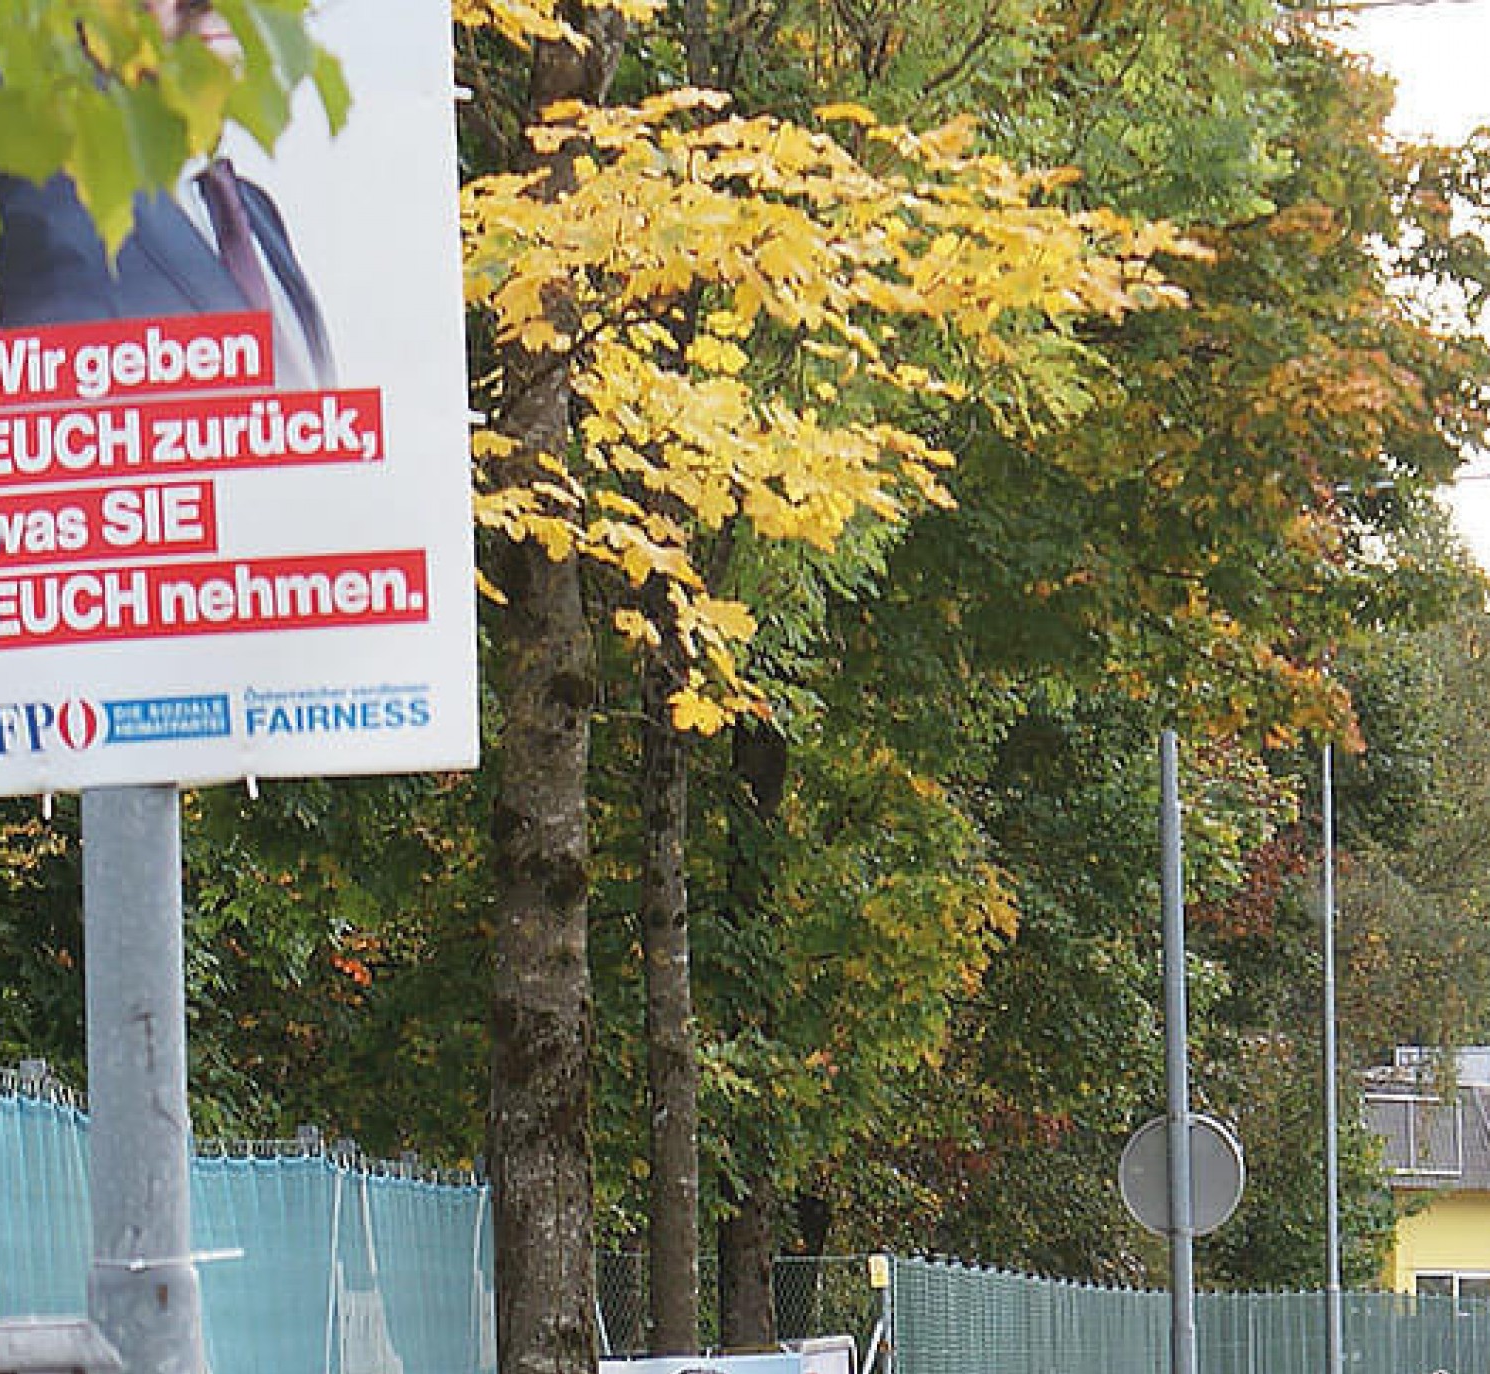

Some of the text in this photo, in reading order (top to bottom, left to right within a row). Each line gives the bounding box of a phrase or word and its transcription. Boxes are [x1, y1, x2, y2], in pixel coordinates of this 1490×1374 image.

[75, 328, 260, 398] geben
[151, 398, 376, 462] zurück,
[101, 485, 204, 545] SIE
[159, 564, 425, 625] nehmen.
[245, 700, 431, 736] FAIRNESS
